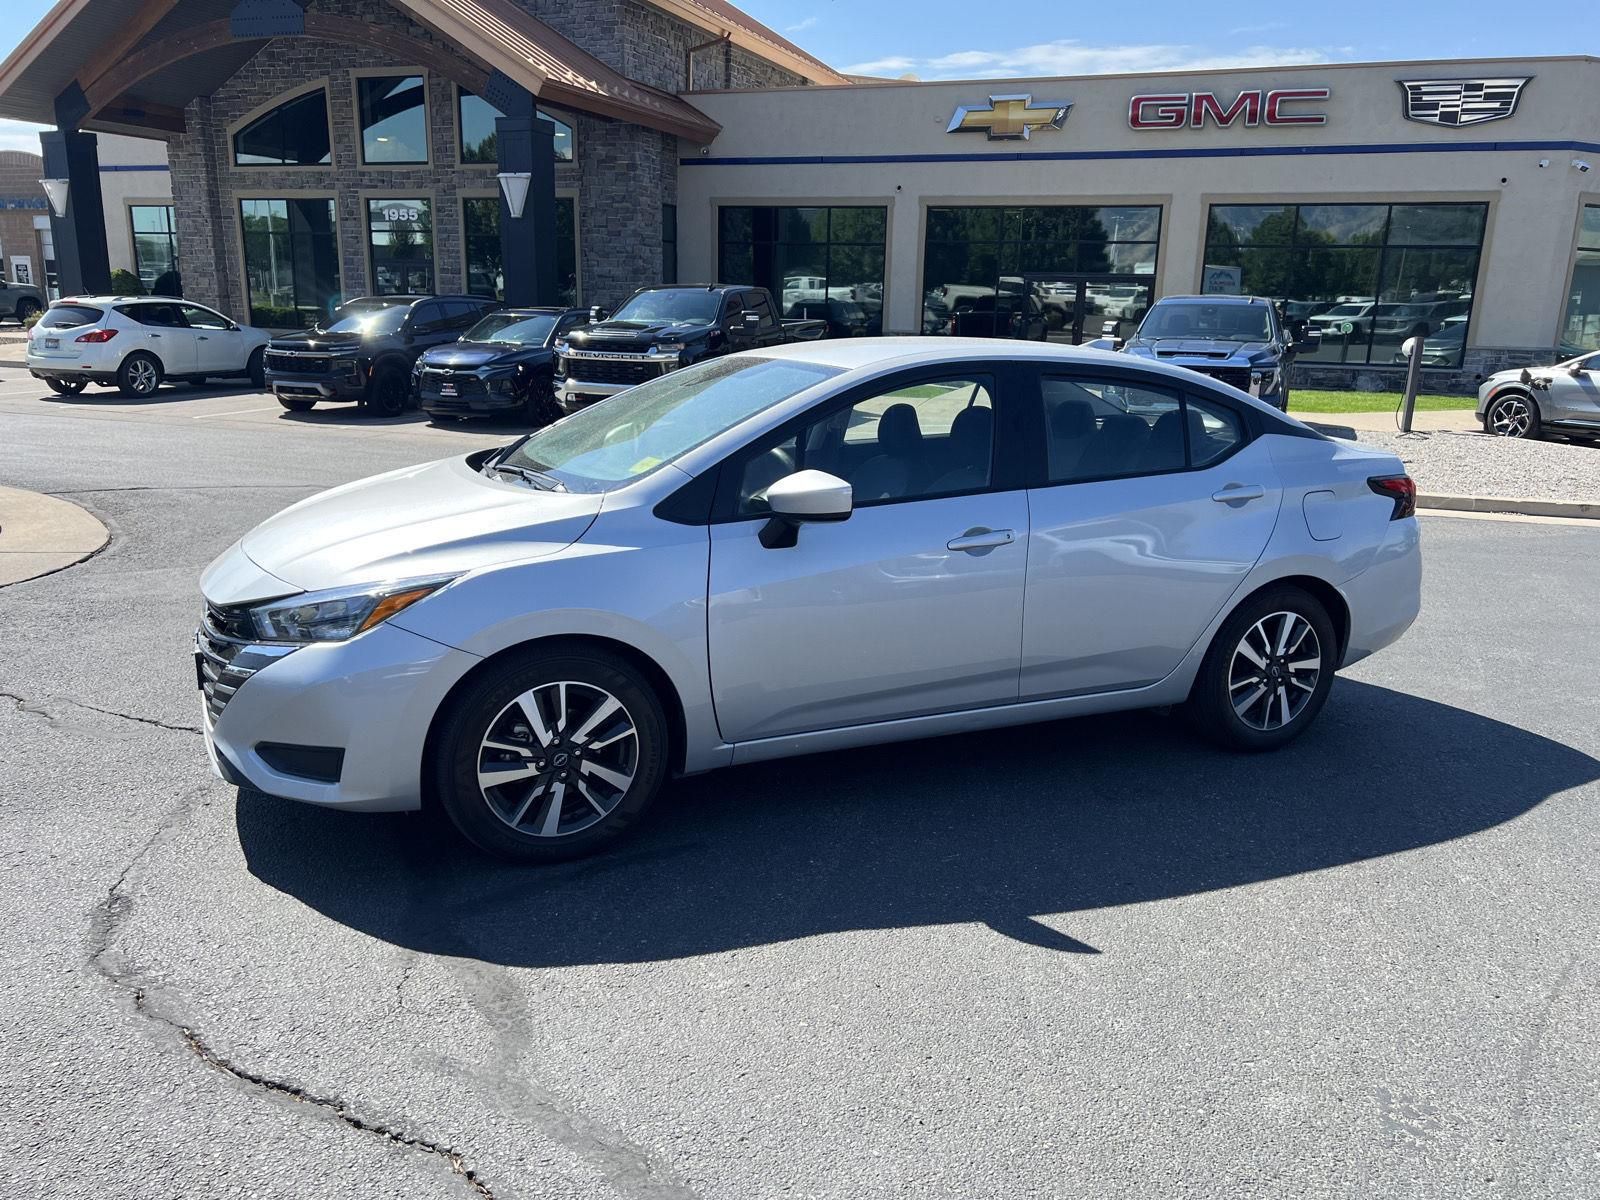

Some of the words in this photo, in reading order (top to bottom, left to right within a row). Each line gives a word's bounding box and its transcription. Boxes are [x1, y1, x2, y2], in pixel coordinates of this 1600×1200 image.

[1128, 88, 1330, 130] GMC
[382, 208, 419, 221] 1955
[566, 351, 650, 360] CHEVROLET
